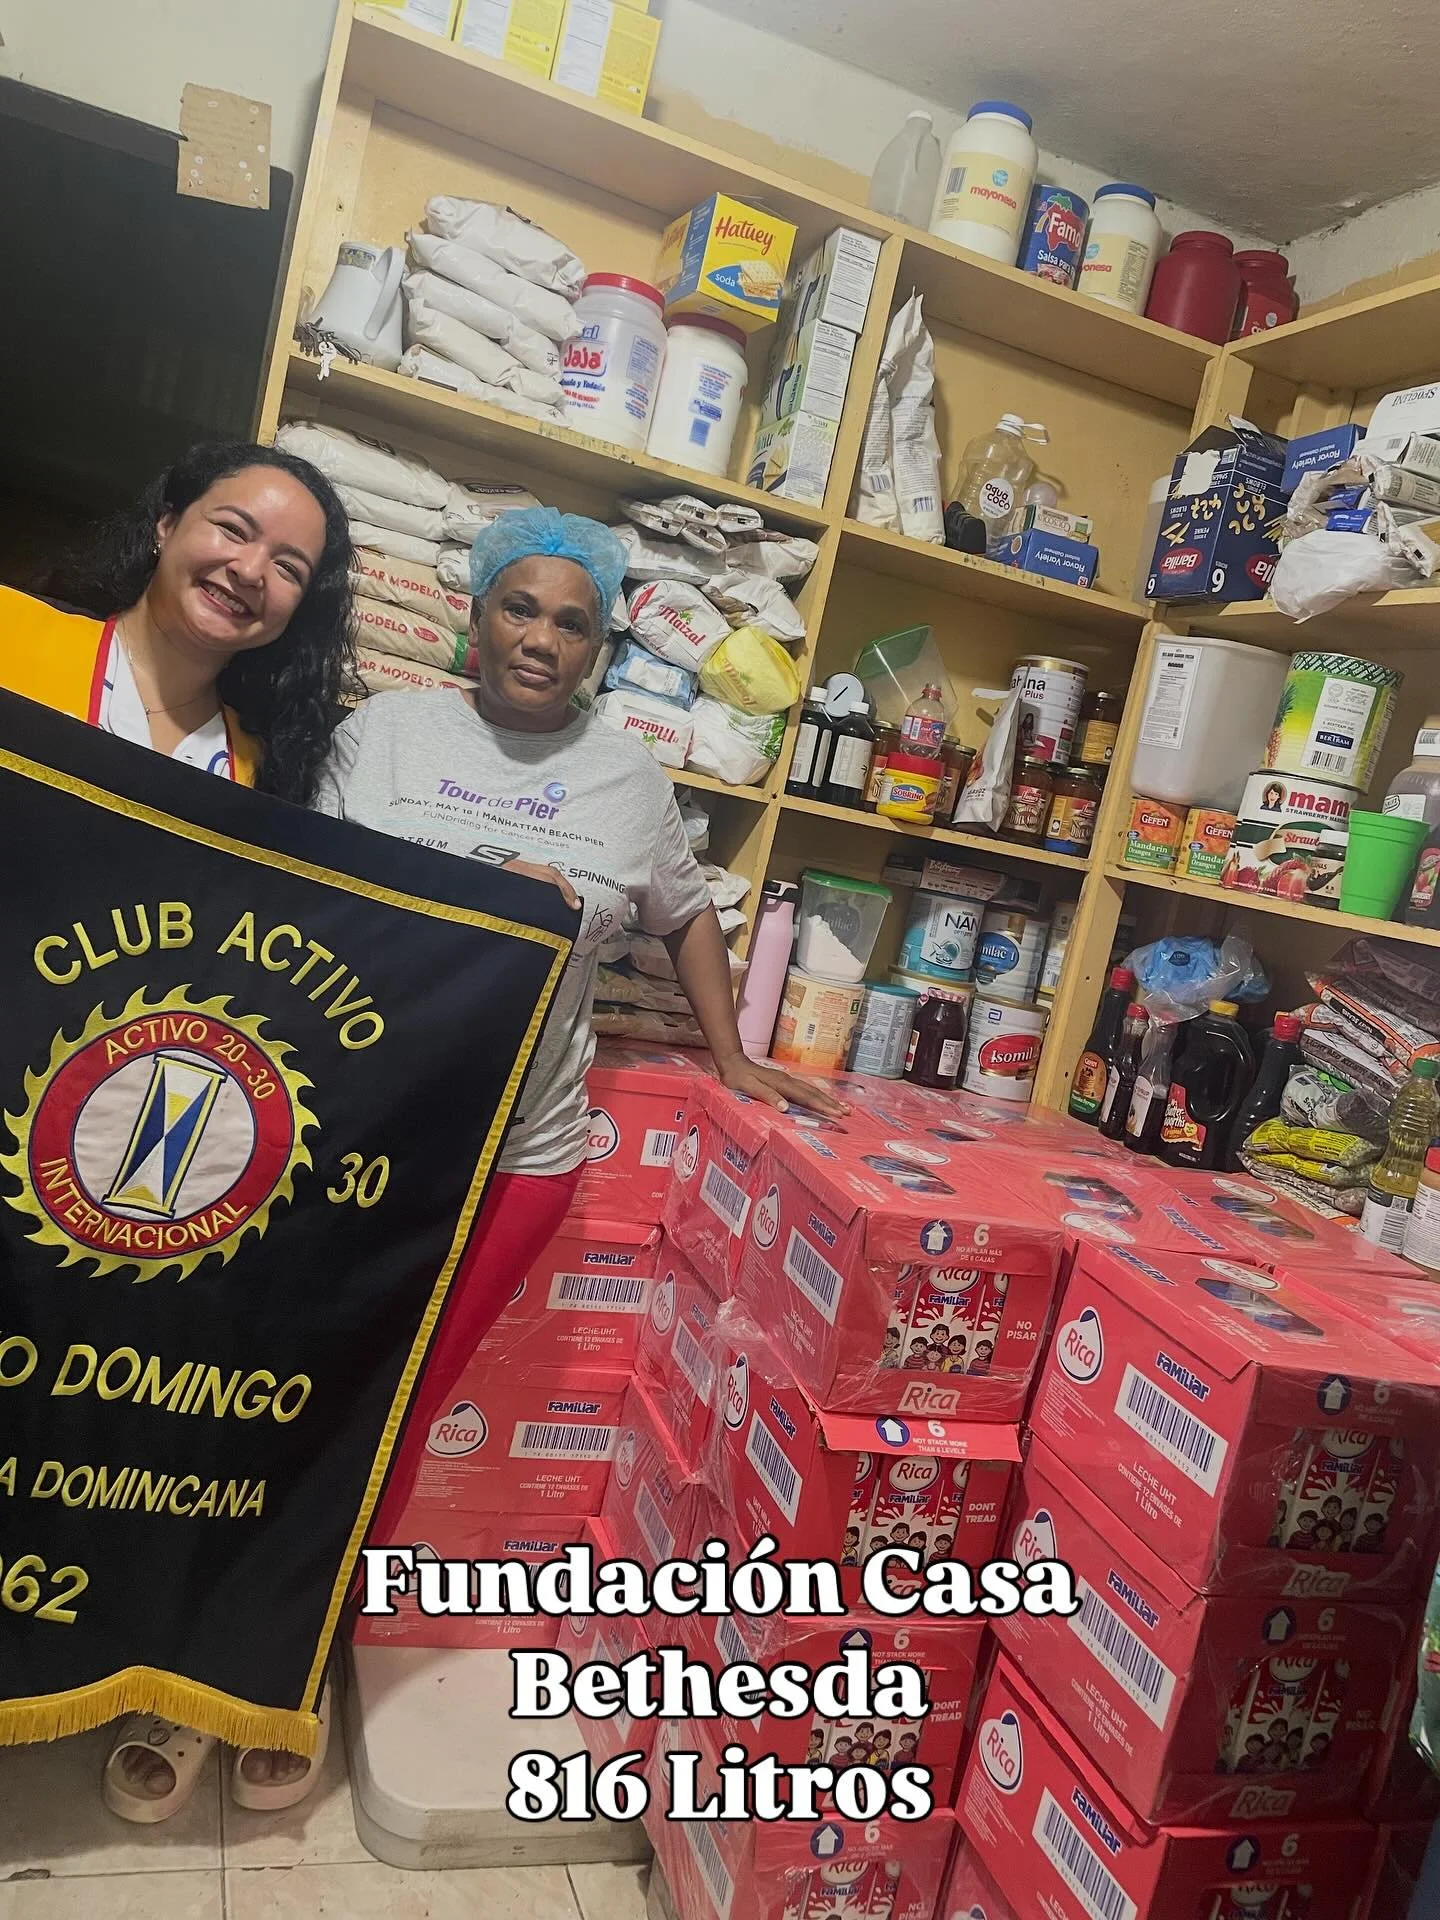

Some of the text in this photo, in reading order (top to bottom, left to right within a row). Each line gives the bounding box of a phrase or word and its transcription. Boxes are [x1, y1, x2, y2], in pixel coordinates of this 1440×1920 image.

[715, 216, 774, 256] Hatuey
[1037, 249, 1058, 267] Salsa
[714, 273, 737, 287] soda
[1291, 449, 1341, 470] Flavor Variety
[1034, 551, 1086, 574] Flavor Variety
[1163, 553, 1199, 570] Barilla
[389, 575, 441, 600] MODELO
[658, 604, 707, 648] Maizal
[379, 664, 434, 688] MODELO
[1024, 690, 1045, 700] Plus
[623, 715, 676, 744] Maizal
[1319, 734, 1351, 747] BERTRAM
[437, 778, 560, 821] Tour de Pier
[892, 787, 924, 801] SOBRINO
[1141, 814, 1169, 827] GEFEN
[1285, 807, 1329, 821] STRAWBERRY
[435, 801, 459, 813] MAY
[482, 811, 547, 835] MANHATTAN
[549, 829, 583, 844] BEACH
[584, 836, 606, 849] PIER
[484, 824, 498, 833] for
[1205, 825, 1234, 839] GEFEN
[1128, 846, 1152, 857] Oranges
[1129, 839, 1168, 854] Mandarin
[1191, 859, 1217, 870] Oranges
[567, 867, 627, 895] SPINNING
[944, 912, 980, 932] NAN
[33, 900, 386, 1052] CLUB ACTIVO
[990, 1045, 1034, 1066] Isomil
[1305, 1036, 1329, 1054] LIGHT
[103, 1018, 276, 1100] ACTIVO 20-30
[326, 1151, 391, 1209] 30
[39, 1157, 249, 1251] INTERNACIONAL
[757, 1203, 775, 1237] Rica
[973, 1223, 990, 1246] 6
[572, 1326, 617, 1335] LECHE UHT
[1006, 1330, 1037, 1341] PISAR
[1016, 1320, 1033, 1330] NO
[583, 1343, 601, 1352] Litro
[1063, 1324, 1095, 1371] Rica
[0, 1334, 313, 1424] O DOMINGO
[727, 1373, 744, 1416] Rica
[902, 1385, 960, 1411] Rica
[435, 1423, 478, 1444] Rica
[927, 1419, 946, 1438] 6
[912, 1437, 968, 1448] NOT STACK MORE
[918, 1445, 966, 1455] THAN LEVELS
[535, 1473, 582, 1483] LECHE UHT
[896, 1462, 933, 1480] Rica
[30, 1460, 267, 1519] DOMINICANA
[1133, 1461, 1177, 1506] LECHE UHT
[546, 1490, 565, 1499] Litro
[1117, 1462, 1143, 1492] CONTIENE
[1173, 1514, 1183, 1528] DE
[968, 1502, 996, 1512] DONT
[1140, 1496, 1158, 1520] Litro
[965, 1514, 997, 1524] TREAD
[0, 1554, 90, 1626] 62
[502, 1625, 521, 1634] Litro
[1316, 1607, 1337, 1632] 6
[893, 1628, 912, 1650] 6
[887, 1651, 907, 1659] STACK
[933, 1700, 961, 1711] DONT
[1085, 1679, 1128, 1733] LECHE UHT
[930, 1711, 962, 1723] TREAD
[1092, 1715, 1110, 1744] Litro
[986, 1726, 1016, 1779] Rica
[864, 1820, 881, 1844] 6
[1280, 1832, 1300, 1857] 6
